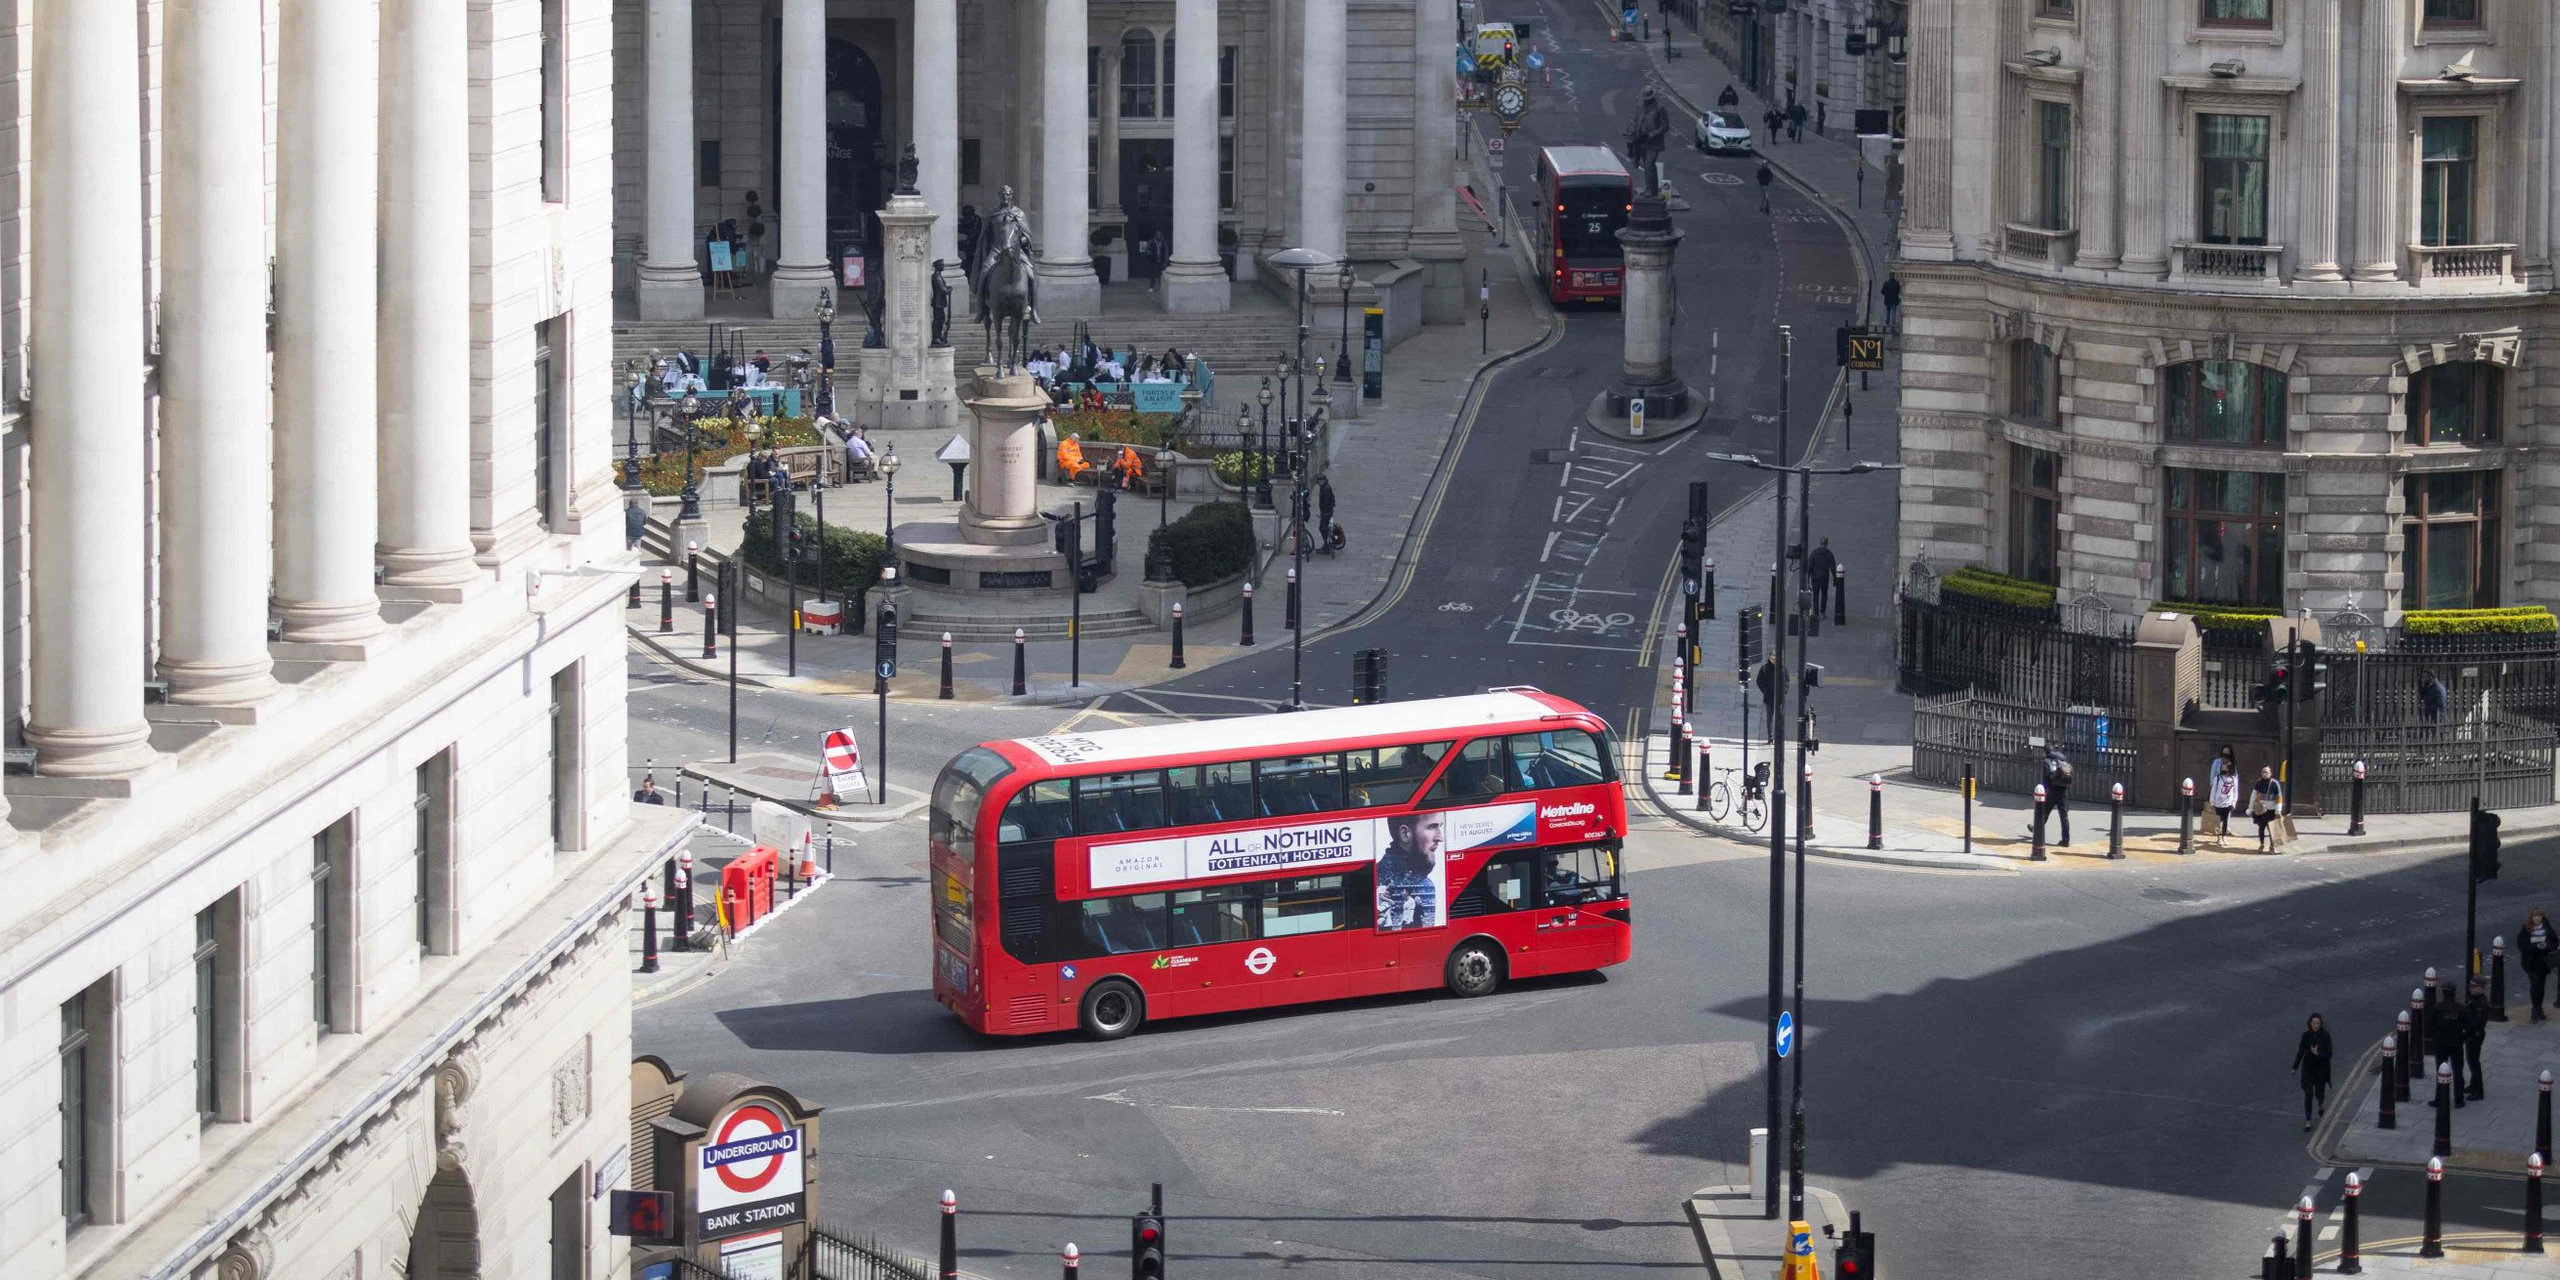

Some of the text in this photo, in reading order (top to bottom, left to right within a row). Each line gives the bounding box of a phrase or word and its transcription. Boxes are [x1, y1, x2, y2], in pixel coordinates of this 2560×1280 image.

[1588, 222, 1601, 233] 25
[1850, 360, 1881, 369] CORNHILL
[1540, 802, 1595, 819] Metroline
[1459, 821, 1494, 830] NEW SERIES
[1468, 828, 1493, 836] AUGUST
[1209, 826, 1352, 856] ALL OR NOTHING
[1118, 855, 1161, 865] AMAZON
[1209, 847, 1352, 870] TOTTENHAM HOTSPUR
[1115, 863, 1165, 873] ORIGINAL
[707, 1135, 793, 1164] UNDERGROUND
[707, 1202, 795, 1231] BANK STATION
